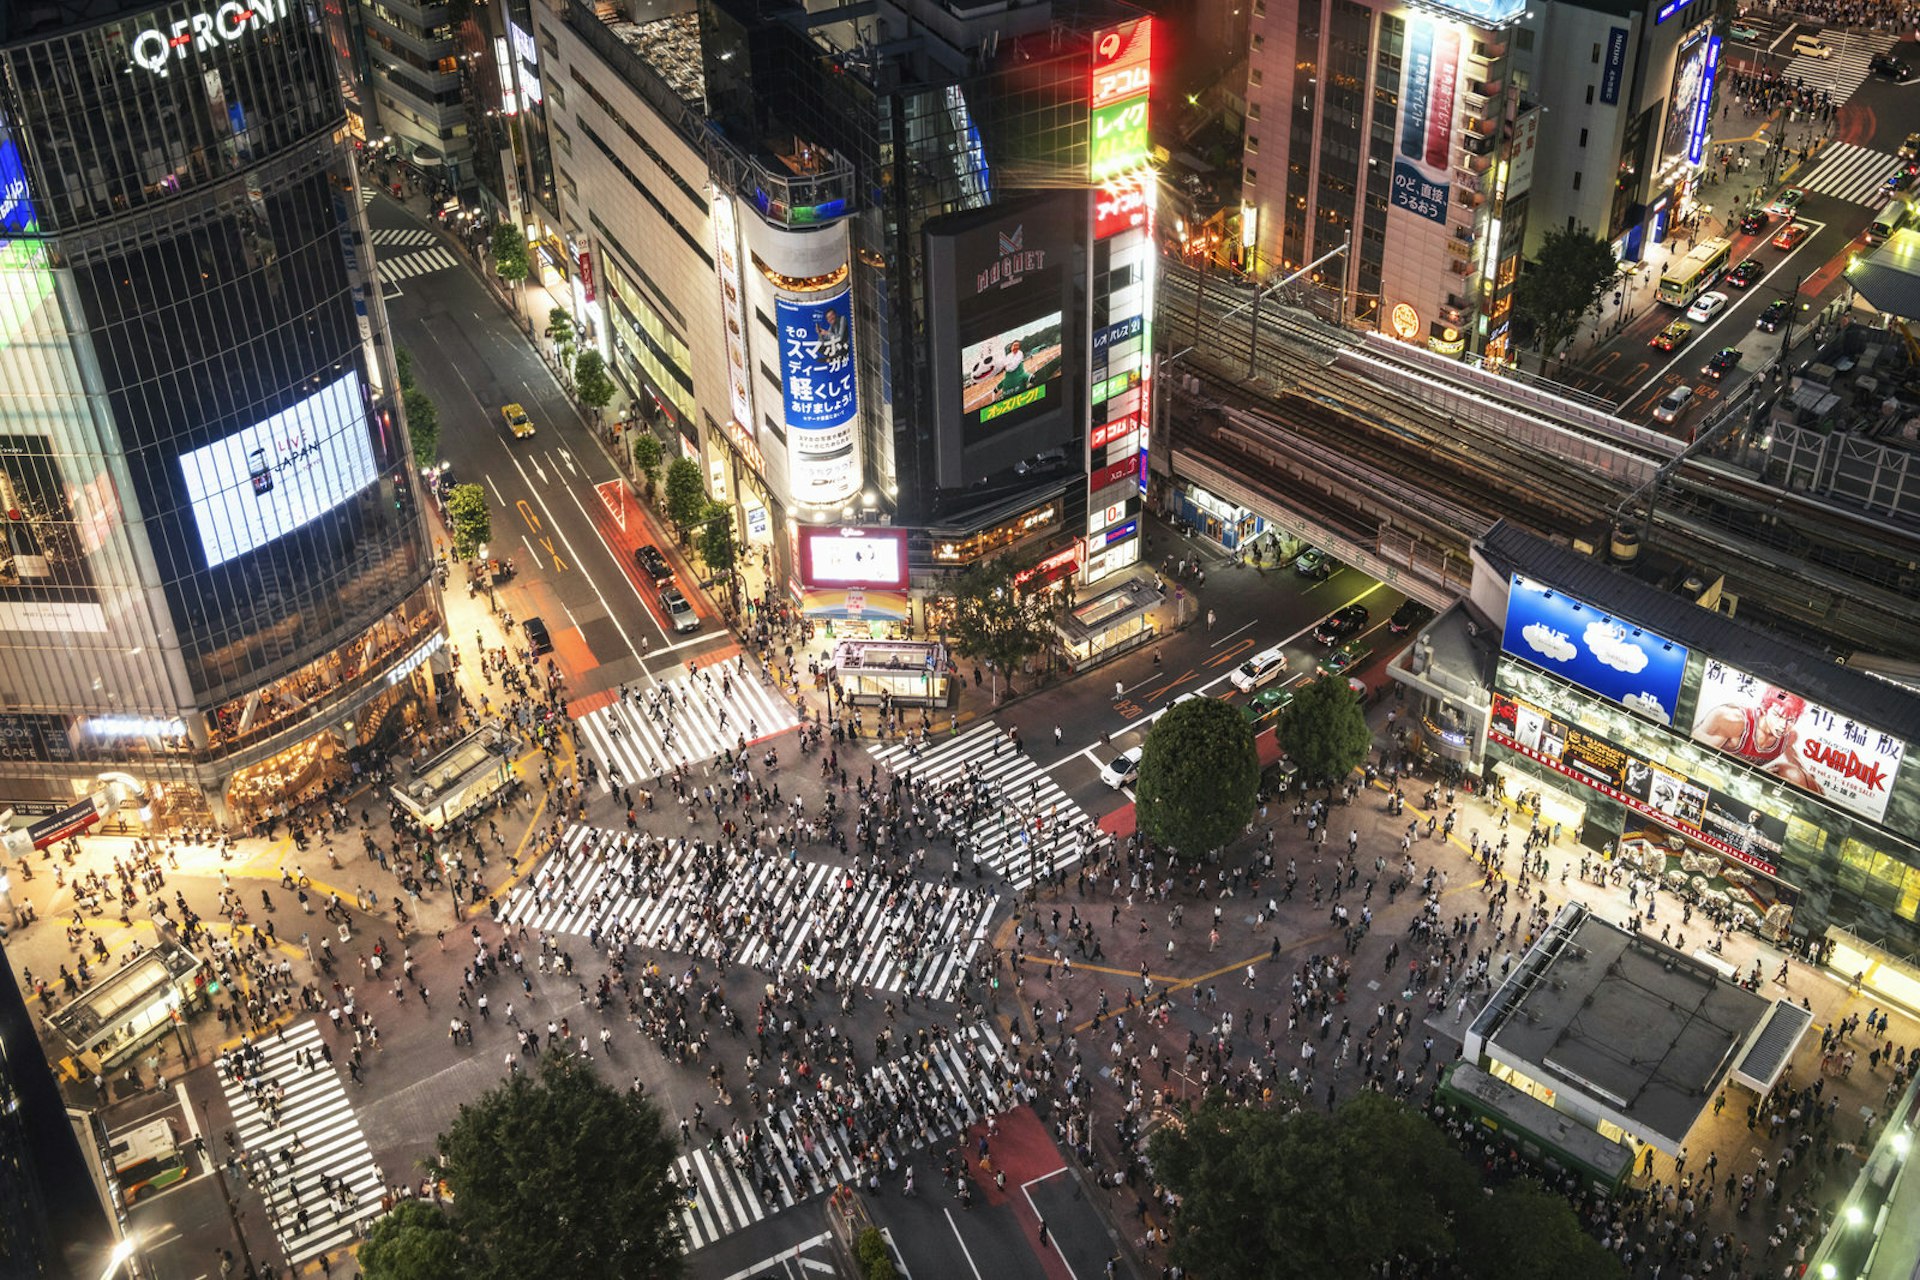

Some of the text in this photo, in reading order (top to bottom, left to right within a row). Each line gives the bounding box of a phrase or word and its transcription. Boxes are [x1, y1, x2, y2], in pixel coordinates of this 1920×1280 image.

[1099, 67, 1149, 99] アコム
[1096, 102, 1146, 139] レイク
[1394, 174, 1448, 207] のど、直接、
[1398, 191, 1439, 218] うるおう
[977, 250, 1046, 293] MAGNET
[785, 325, 808, 339] その
[786, 336, 850, 360] スマホ、
[788, 353, 850, 377] ディーガが
[789, 374, 852, 401] 軽くして
[278, 430, 308, 452] LIVE
[1096, 417, 1127, 443] アコム
[274, 442, 321, 473] JAPAN
[386, 632, 445, 686] TSUTAYA
[1112, 699, 1144, 719] 8-20
